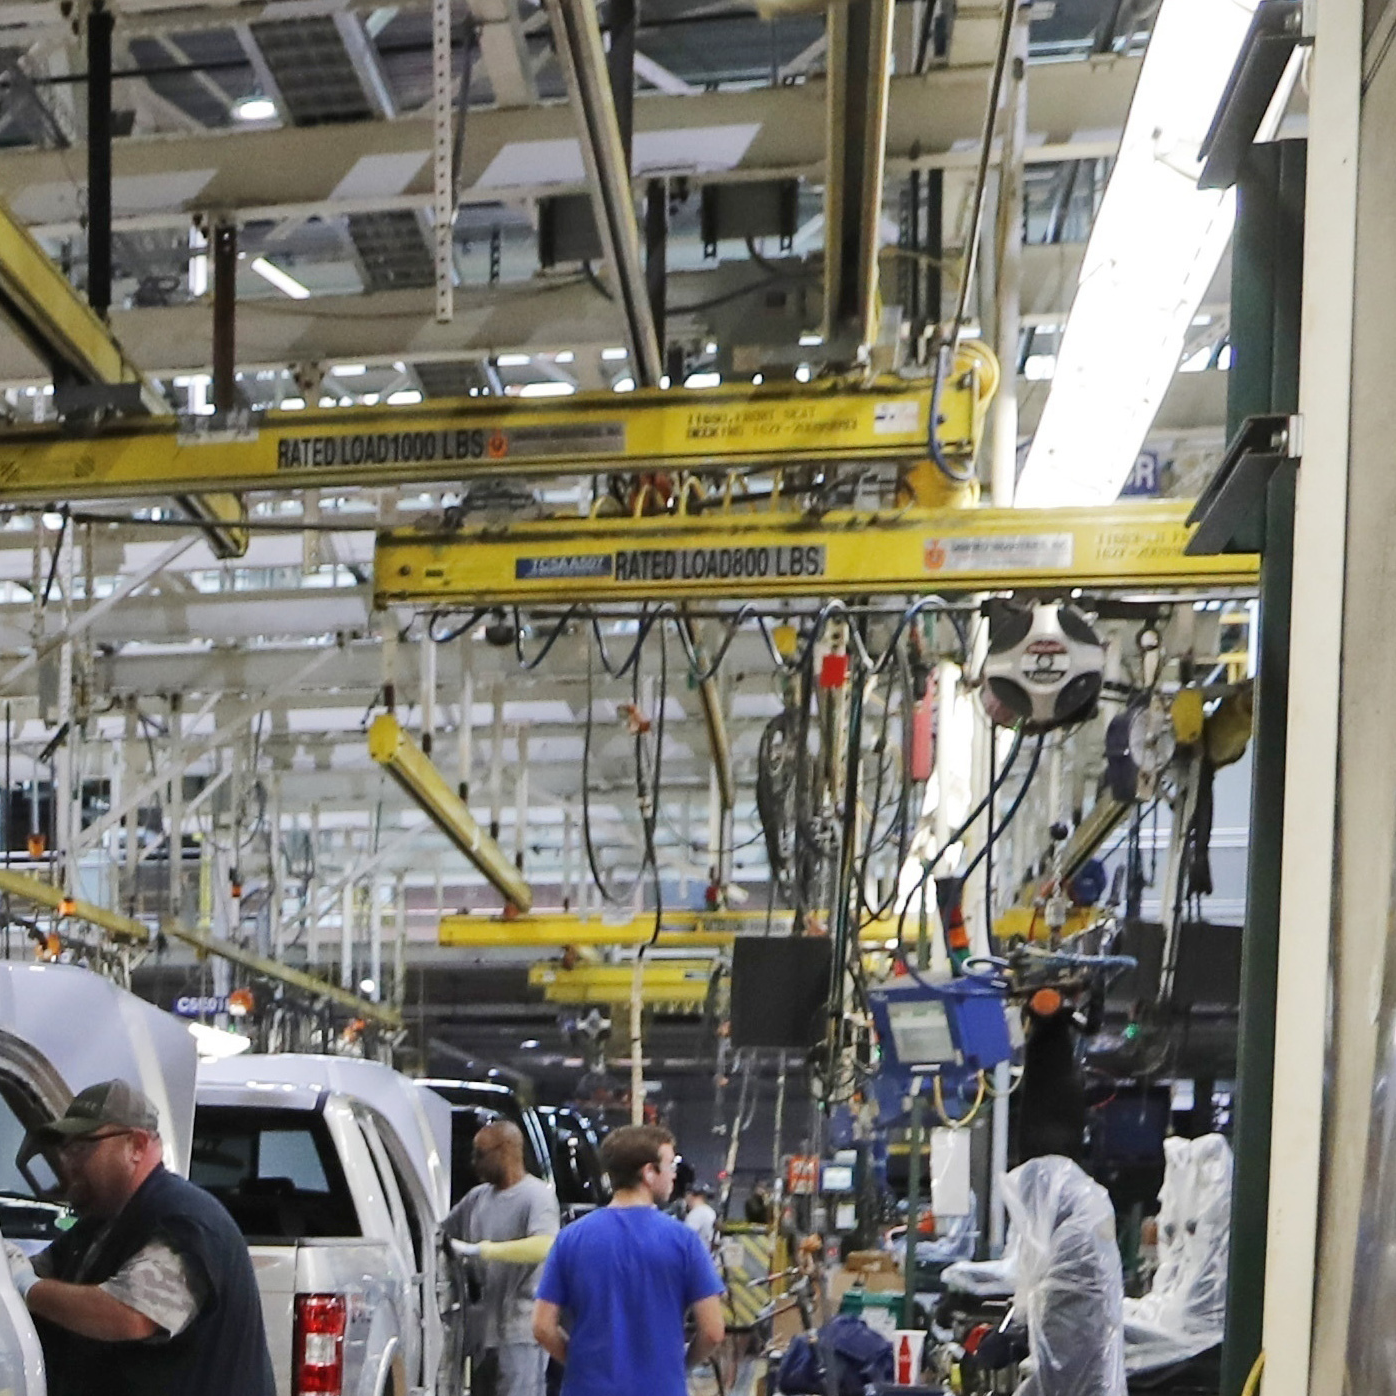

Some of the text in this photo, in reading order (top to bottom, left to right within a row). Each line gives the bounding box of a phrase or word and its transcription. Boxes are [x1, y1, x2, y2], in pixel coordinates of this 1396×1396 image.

[277, 436, 336, 470] RATED
[443, 428, 485, 460] LBS
[614, 550, 677, 581] RATED
